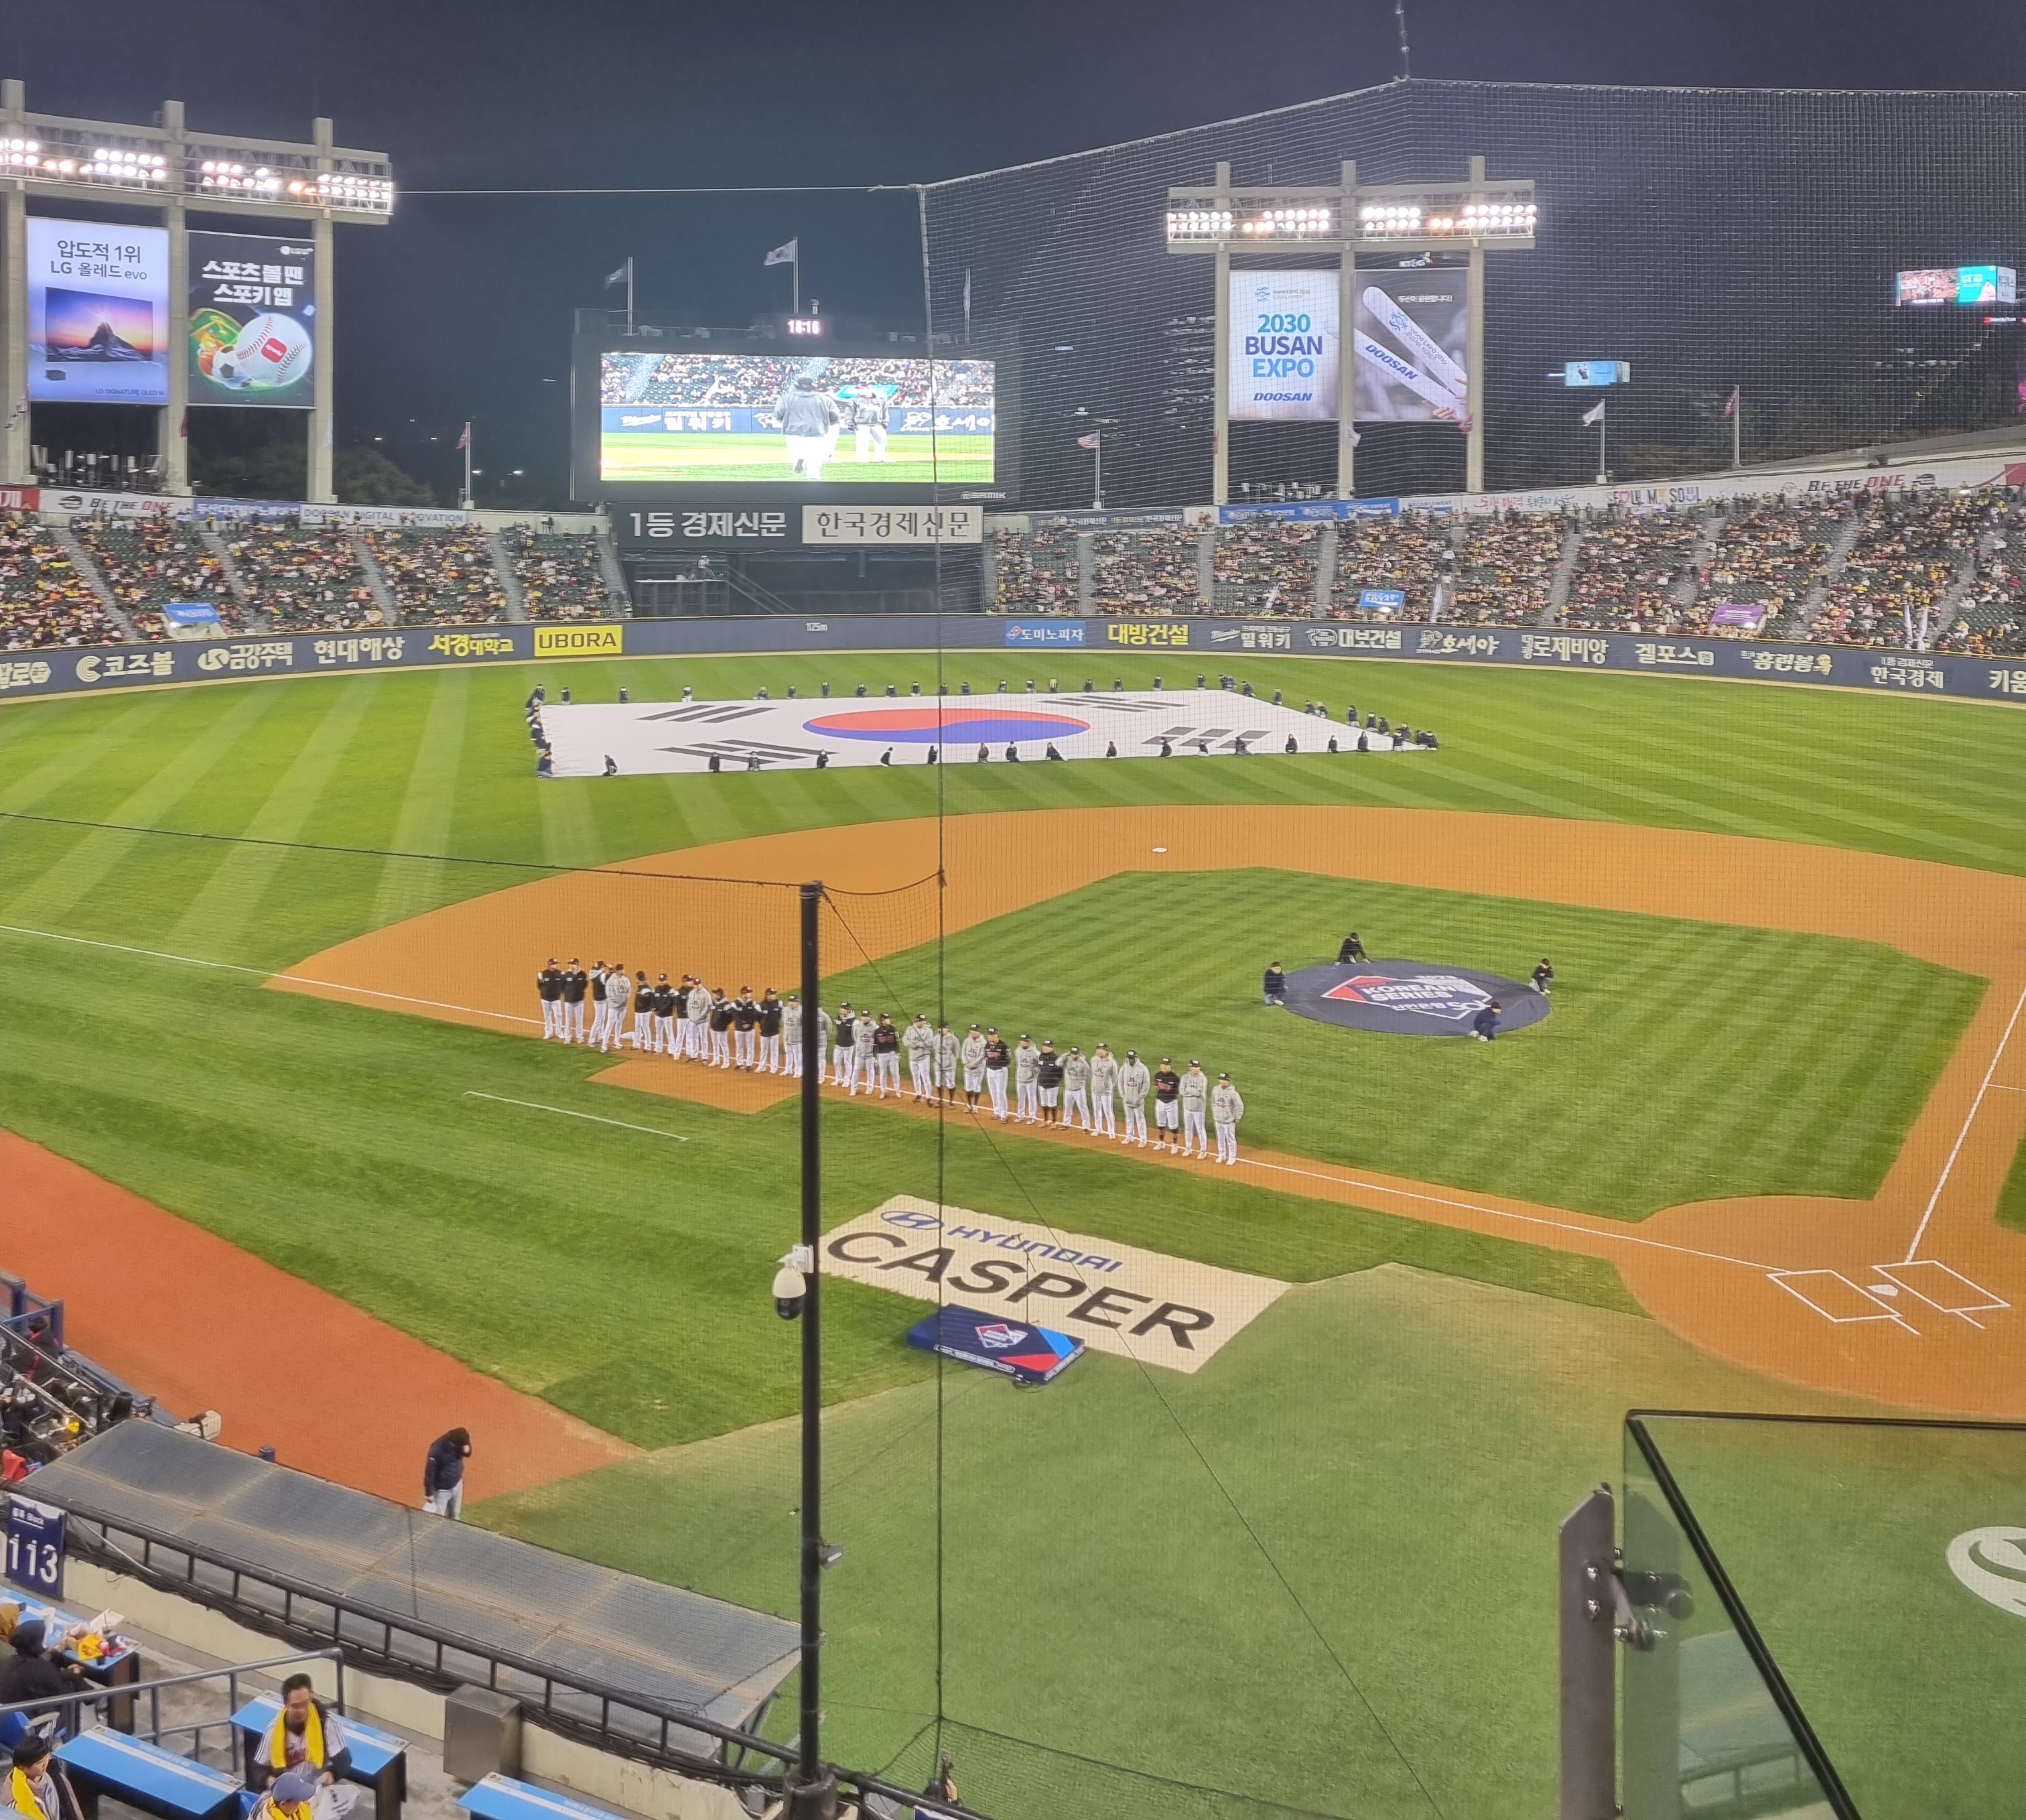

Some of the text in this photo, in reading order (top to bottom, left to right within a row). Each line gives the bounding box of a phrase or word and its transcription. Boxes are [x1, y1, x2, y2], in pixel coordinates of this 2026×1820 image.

[58, 240, 141, 263] 압도적 1위
[51, 261, 147, 279] LG 올레드 evo
[202, 260, 261, 282] 스포츠
[263, 264, 282, 283] 볼
[213, 283, 293, 306] 스포키 앱
[787, 320, 821, 335] 18:16
[1258, 314, 1310, 332] 2030
[1245, 336, 1323, 355] BUSAN
[1423, 340, 1436, 353] EXPO
[1435, 352, 1447, 365] 2030
[1254, 358, 1314, 377] EXPO
[1365, 344, 1418, 380] DOOSAN
[1254, 393, 1312, 401] DOOSAN
[1808, 474, 1906, 491] BE THE ONE
[630, 511, 787, 537] 1등 경제신문
[816, 511, 971, 538] 한국경제신문
[428, 634, 514, 657] 서경대학교
[539, 632, 617, 649] UBORA
[1019, 629, 1085, 641] 도미노피자
[1107, 623, 1189, 646] 대방건설
[1240, 632, 1291, 649] 밀워키
[1338, 629, 1402, 649] 대보건설
[1440, 634, 1500, 655] 호세야
[230, 642, 293, 669] 금강주택
[314, 637, 405, 664] 현대해상
[103, 651, 175, 677] 코즈볼
[1871, 666, 1944, 689] 한국경제
[1988, 669, 2026, 694] 키움
[1361, 984, 1458, 996] KOREAN
[1370, 991, 1453, 1002] SERIES
[947, 1225, 1123, 1273] HYUNDAI
[827, 1231, 1215, 1350] CASPER
[9, 1533, 58, 1583] 113
